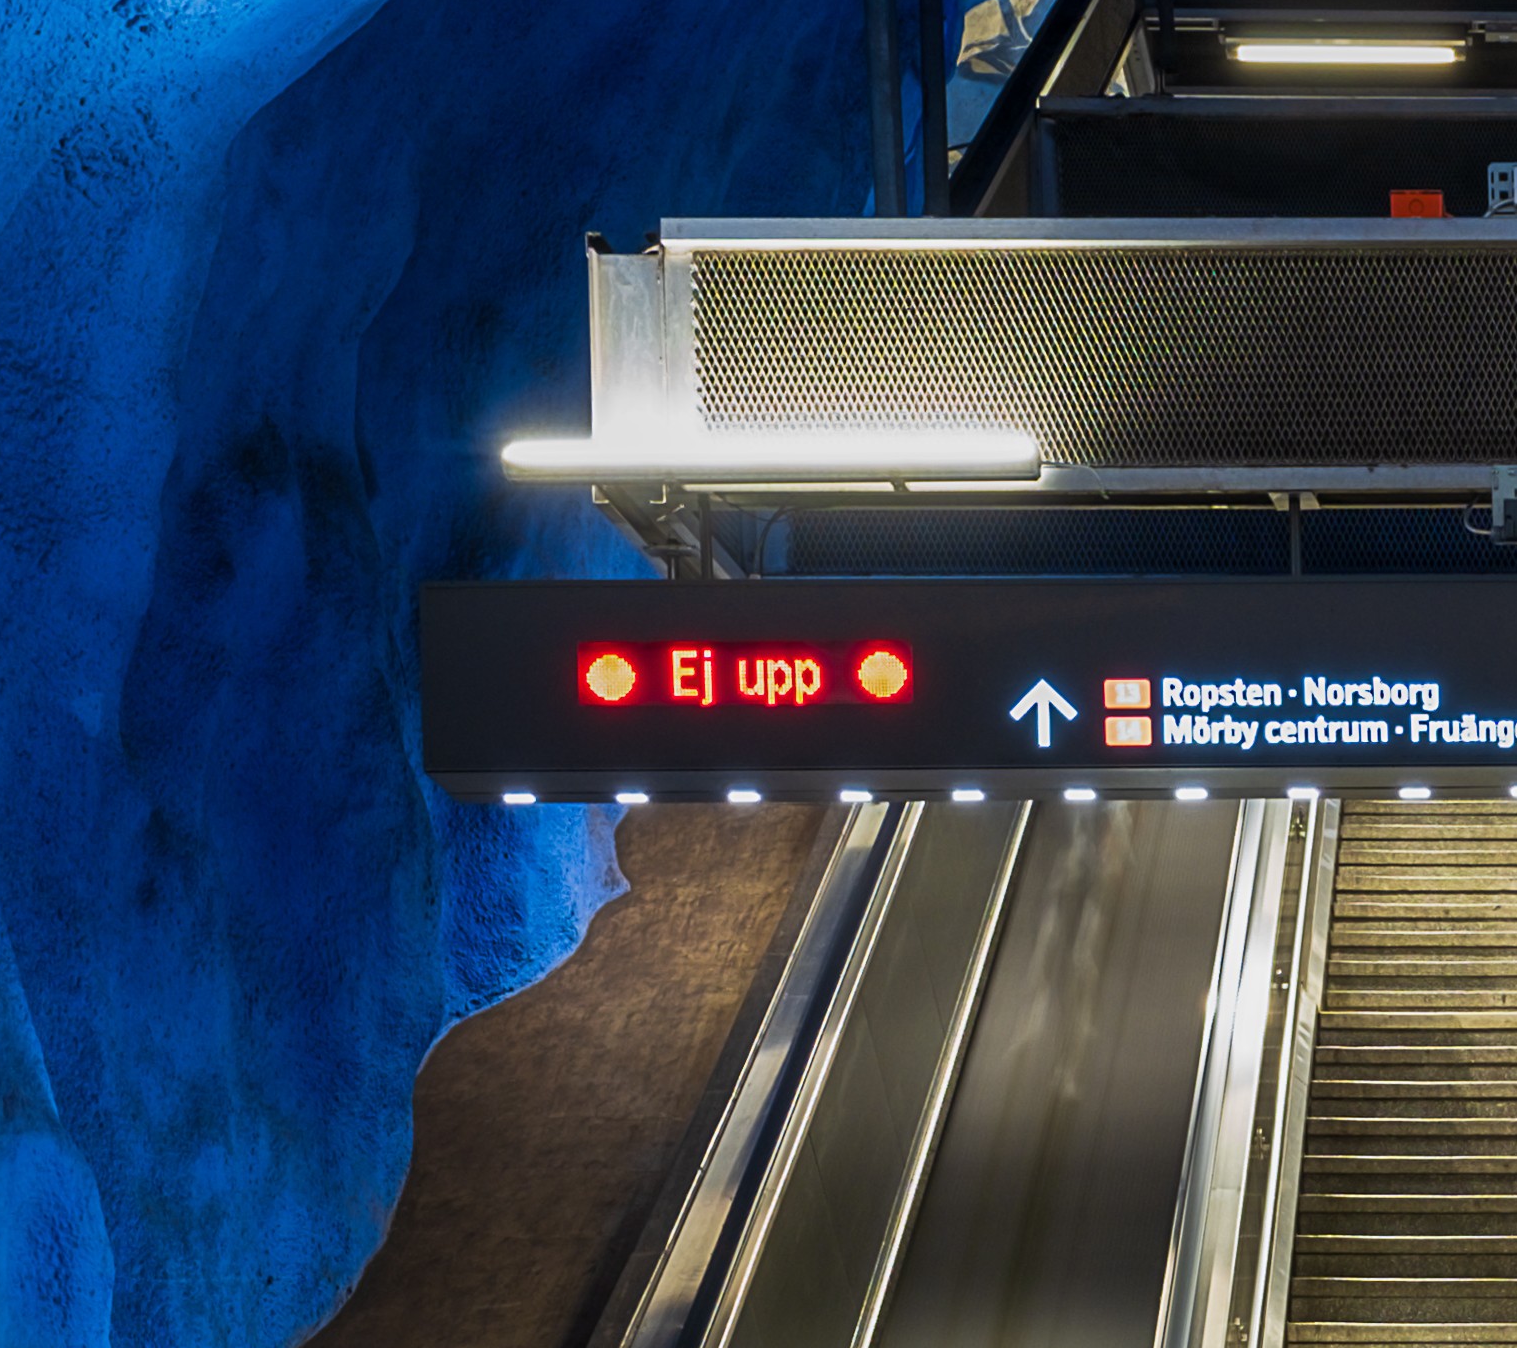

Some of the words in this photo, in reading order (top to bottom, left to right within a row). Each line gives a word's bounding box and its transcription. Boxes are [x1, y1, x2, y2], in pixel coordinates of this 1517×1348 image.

[671, 649, 714, 706] Ej
[738, 658, 822, 706] upp
[1162, 677, 1282, 713] Ropsten
[1304, 676, 1440, 712] Norsborg
[1163, 714, 1259, 750] Mörby
[1264, 715, 1389, 744] centrum
